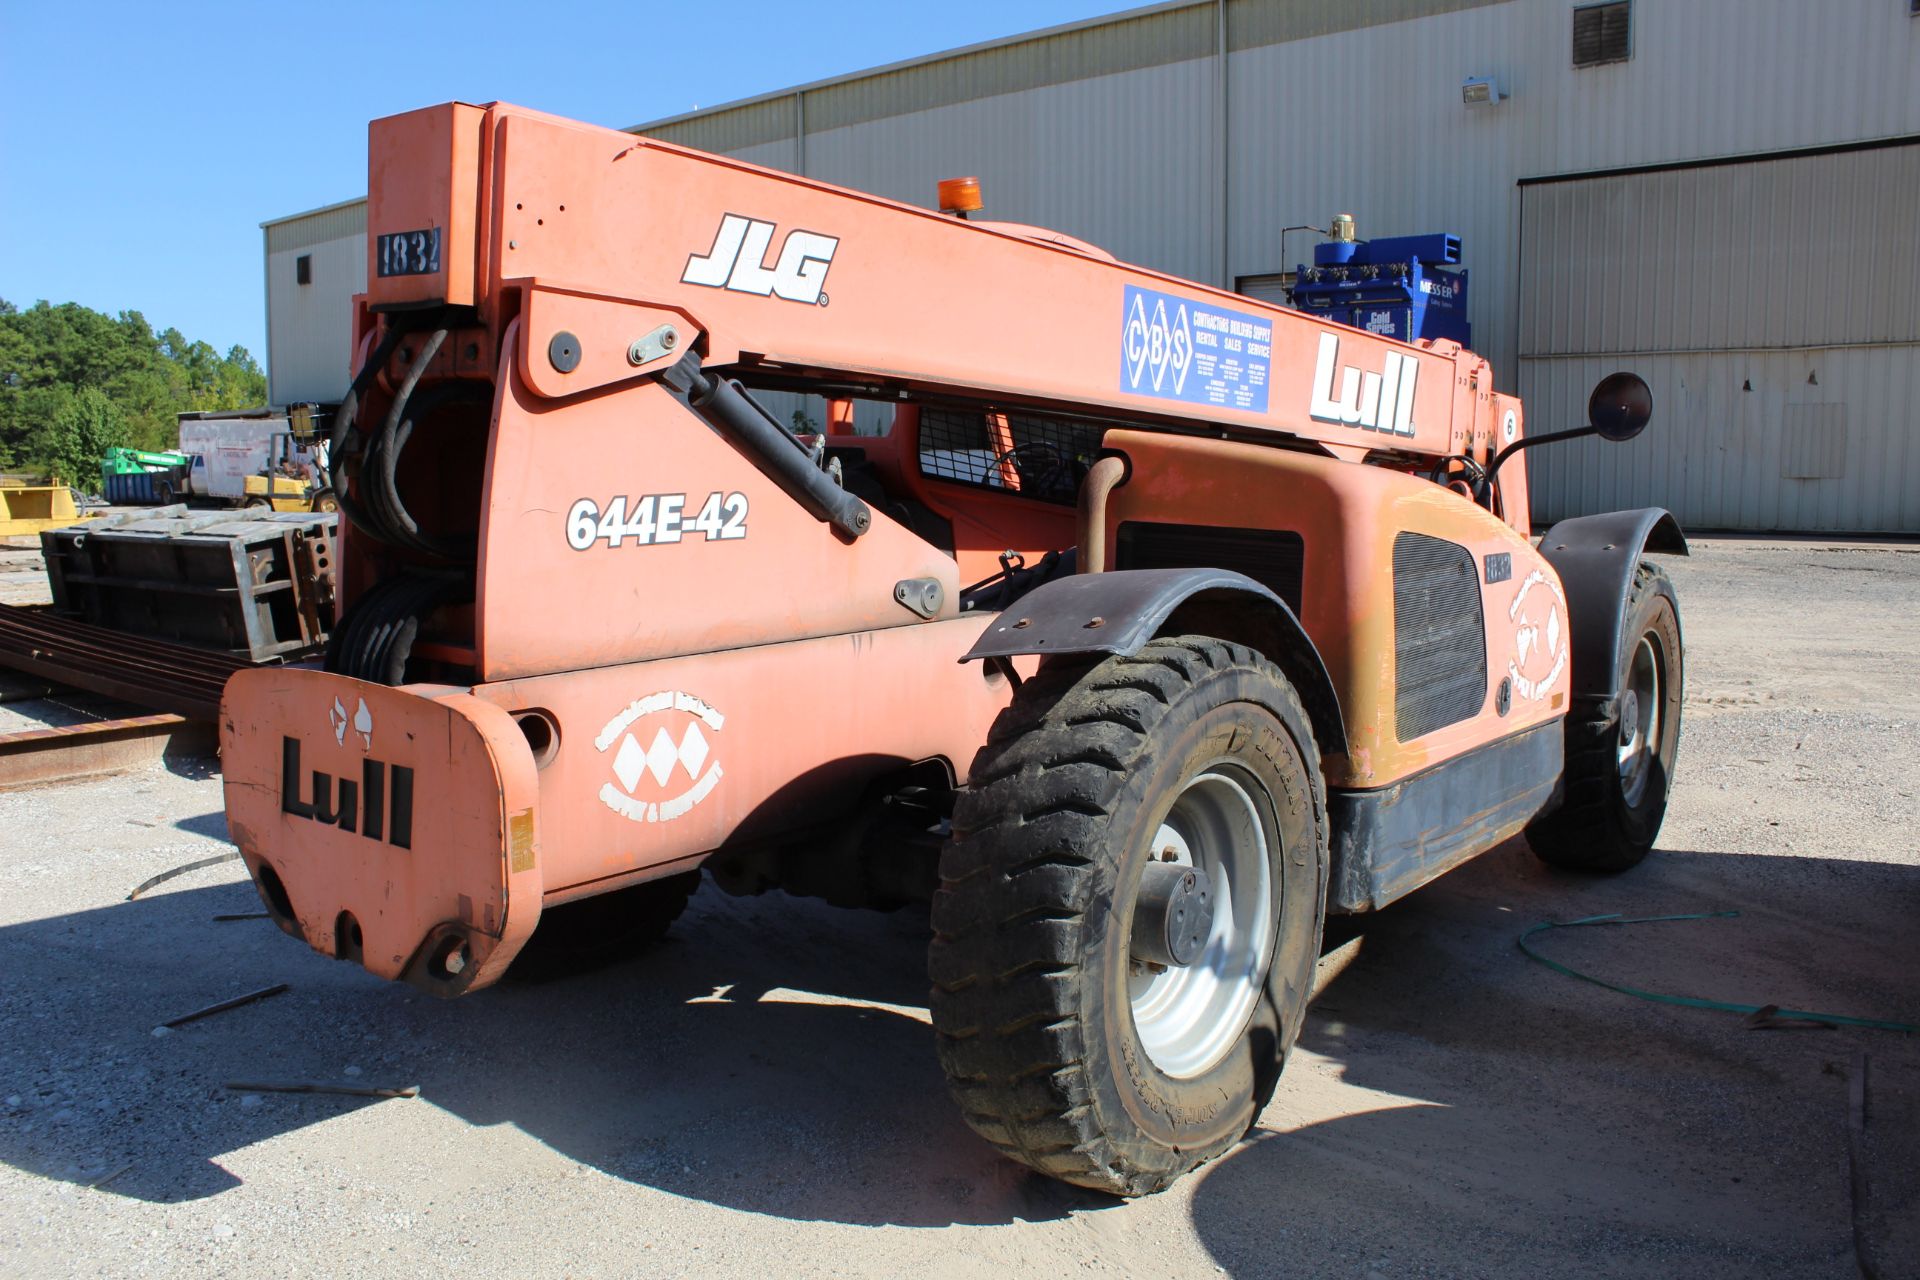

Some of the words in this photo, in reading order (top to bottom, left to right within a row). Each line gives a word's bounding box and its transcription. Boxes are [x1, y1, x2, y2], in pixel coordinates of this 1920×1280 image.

[681, 213, 840, 305] JLG
[1419, 279, 1453, 299] MESSER
[1196, 331, 1218, 348] RENTAL
[1224, 337, 1242, 352] SALES
[1247, 342, 1270, 358] SERVICE
[1365, 321, 1395, 334] Series
[1310, 330, 1419, 436] Lull
[1507, 418, 1514, 436] 6
[566, 492, 748, 551] 644E-42
[282, 735, 414, 850] Lull
